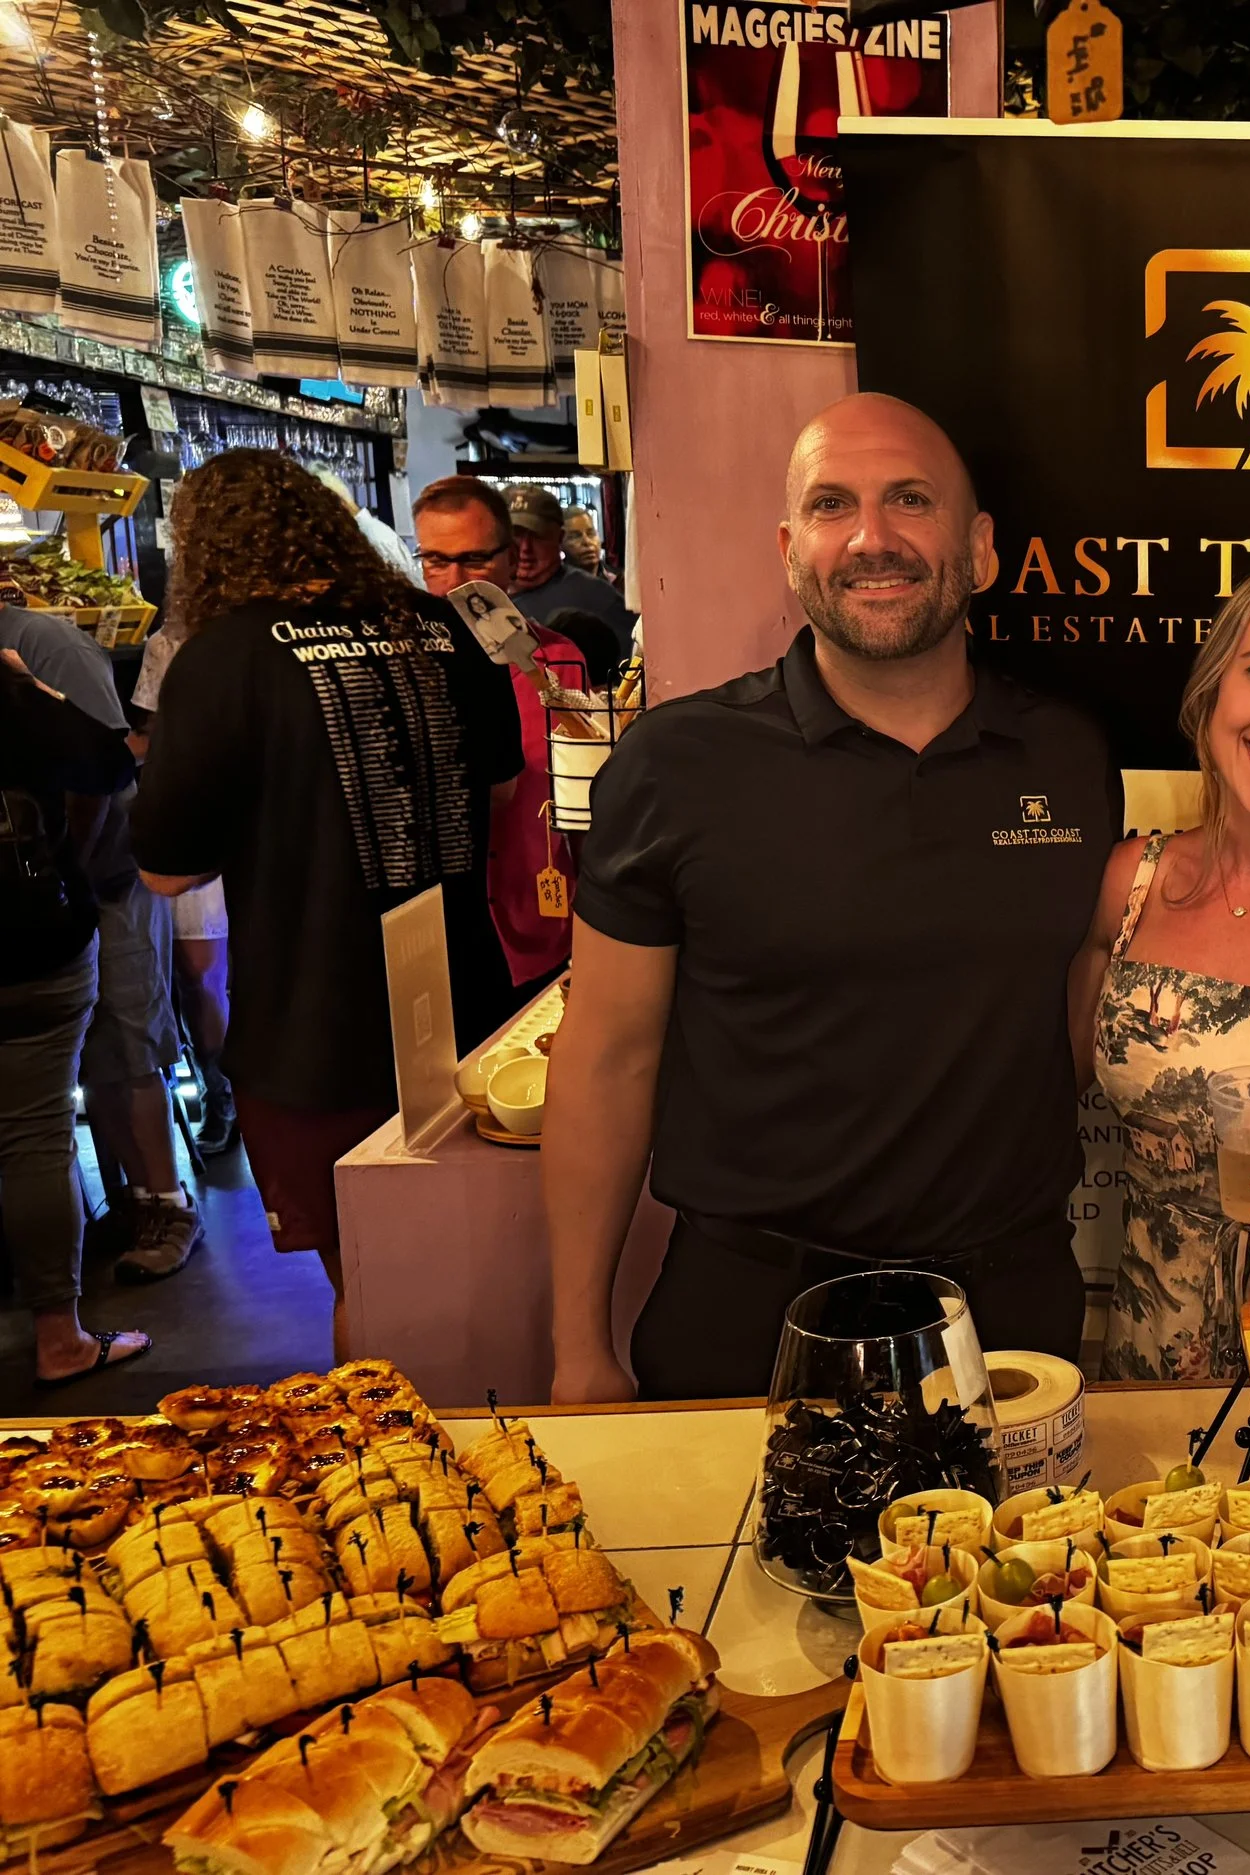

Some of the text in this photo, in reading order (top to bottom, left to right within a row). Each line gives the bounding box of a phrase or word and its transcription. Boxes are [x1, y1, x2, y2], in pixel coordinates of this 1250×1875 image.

[84, 244, 131, 262] Chocolte,
[351, 286, 364, 295] Oh
[700, 287, 762, 308] WINE!
[350, 307, 397, 319] NOTHING
[567, 301, 588, 309] MOM
[700, 303, 853, 329] red, white & all things right
[349, 325, 400, 336] Under Control
[271, 620, 354, 643] Chains
[360, 619, 380, 637] &
[1032, 615, 1212, 645] ESTATE
[292, 642, 367, 663] WORLD
[420, 637, 455, 653] 2025
[991, 827, 1081, 840] COAST TO COAST
[993, 838, 1013, 846] REAL
[1001, 1427, 1038, 1445] TICKET
